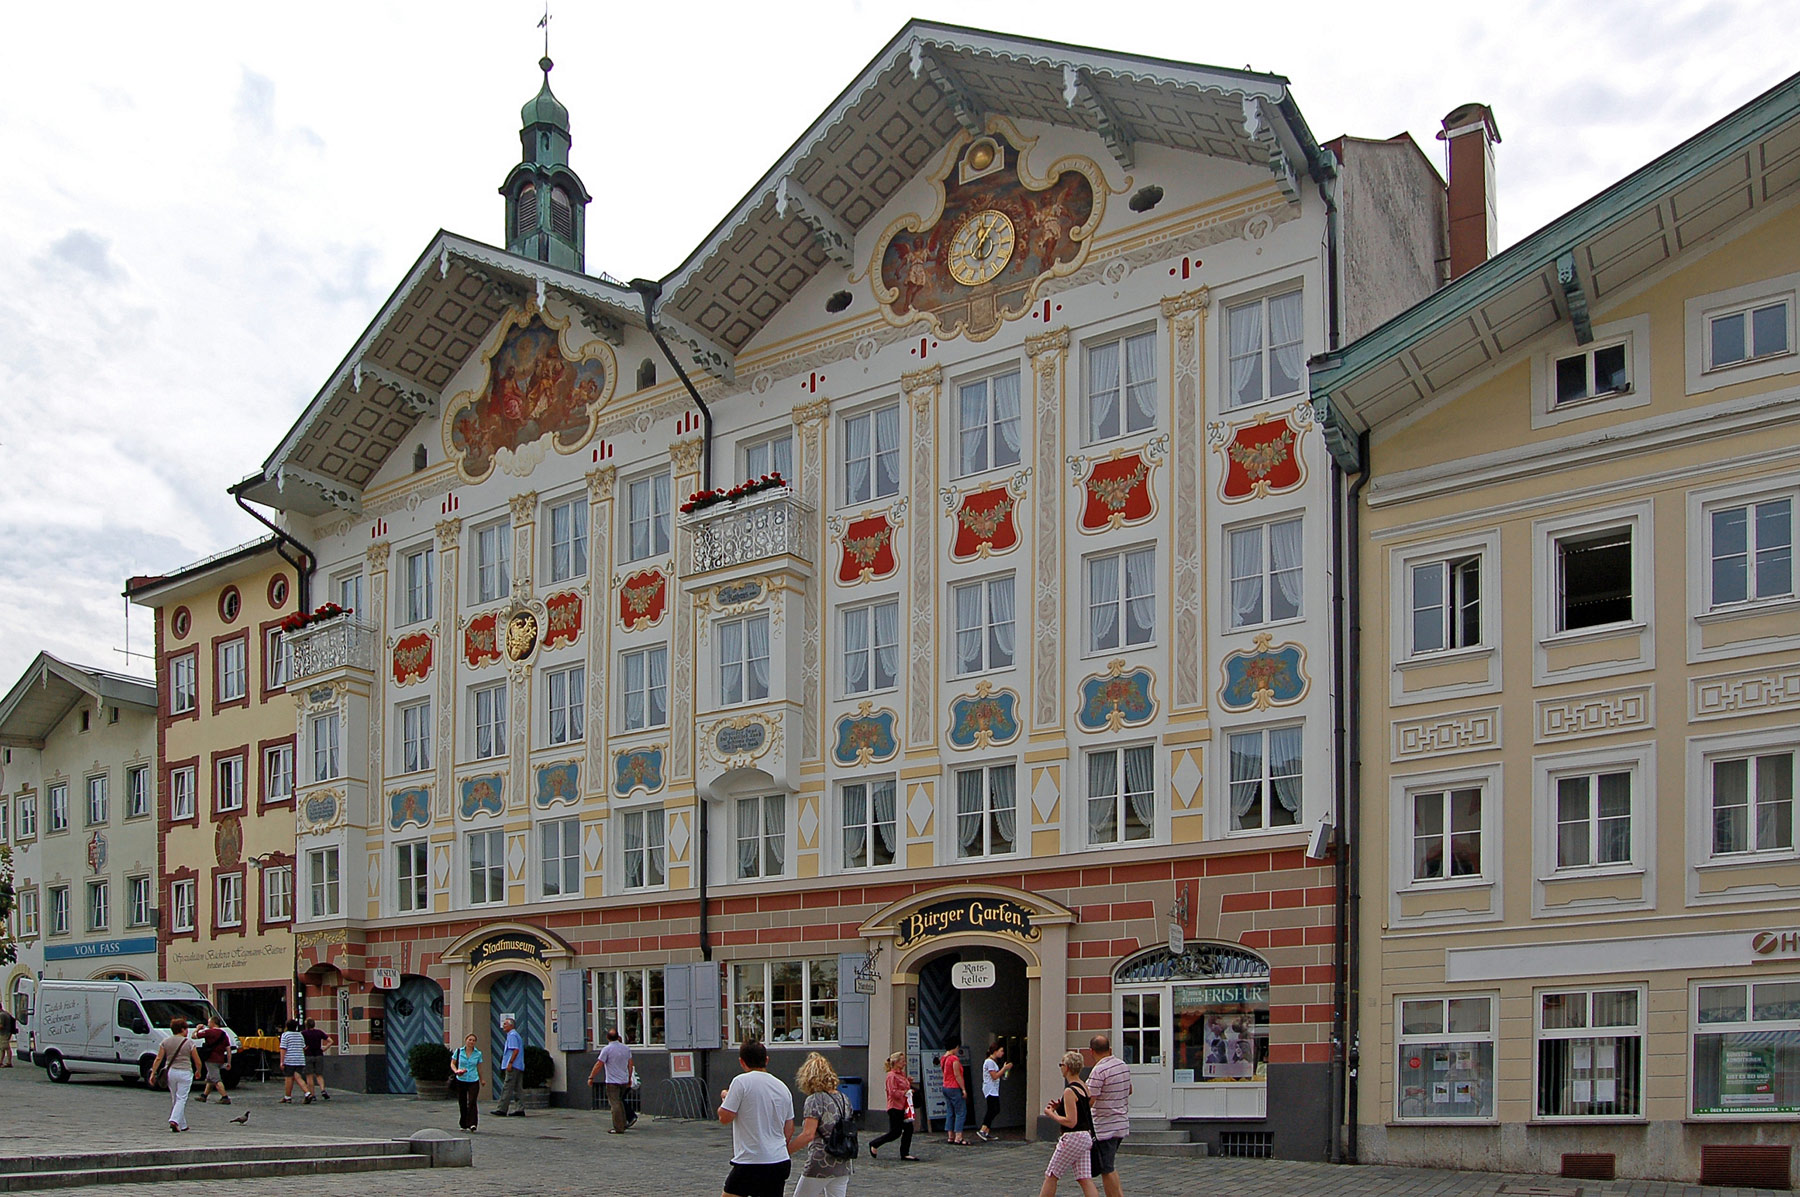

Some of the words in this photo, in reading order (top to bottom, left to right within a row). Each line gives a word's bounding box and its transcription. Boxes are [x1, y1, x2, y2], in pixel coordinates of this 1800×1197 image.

[909, 908, 965, 941] Bürger
[969, 901, 1025, 928] Garten.
[74, 944, 96, 955] VOM
[100, 942, 120, 953] FASS
[482, 939, 536, 957] Stadtmuseum
[1781, 931, 1800, 952] H
[376, 969, 397, 977] MUSEUM
[1204, 987, 1263, 1003] FRISEUR
